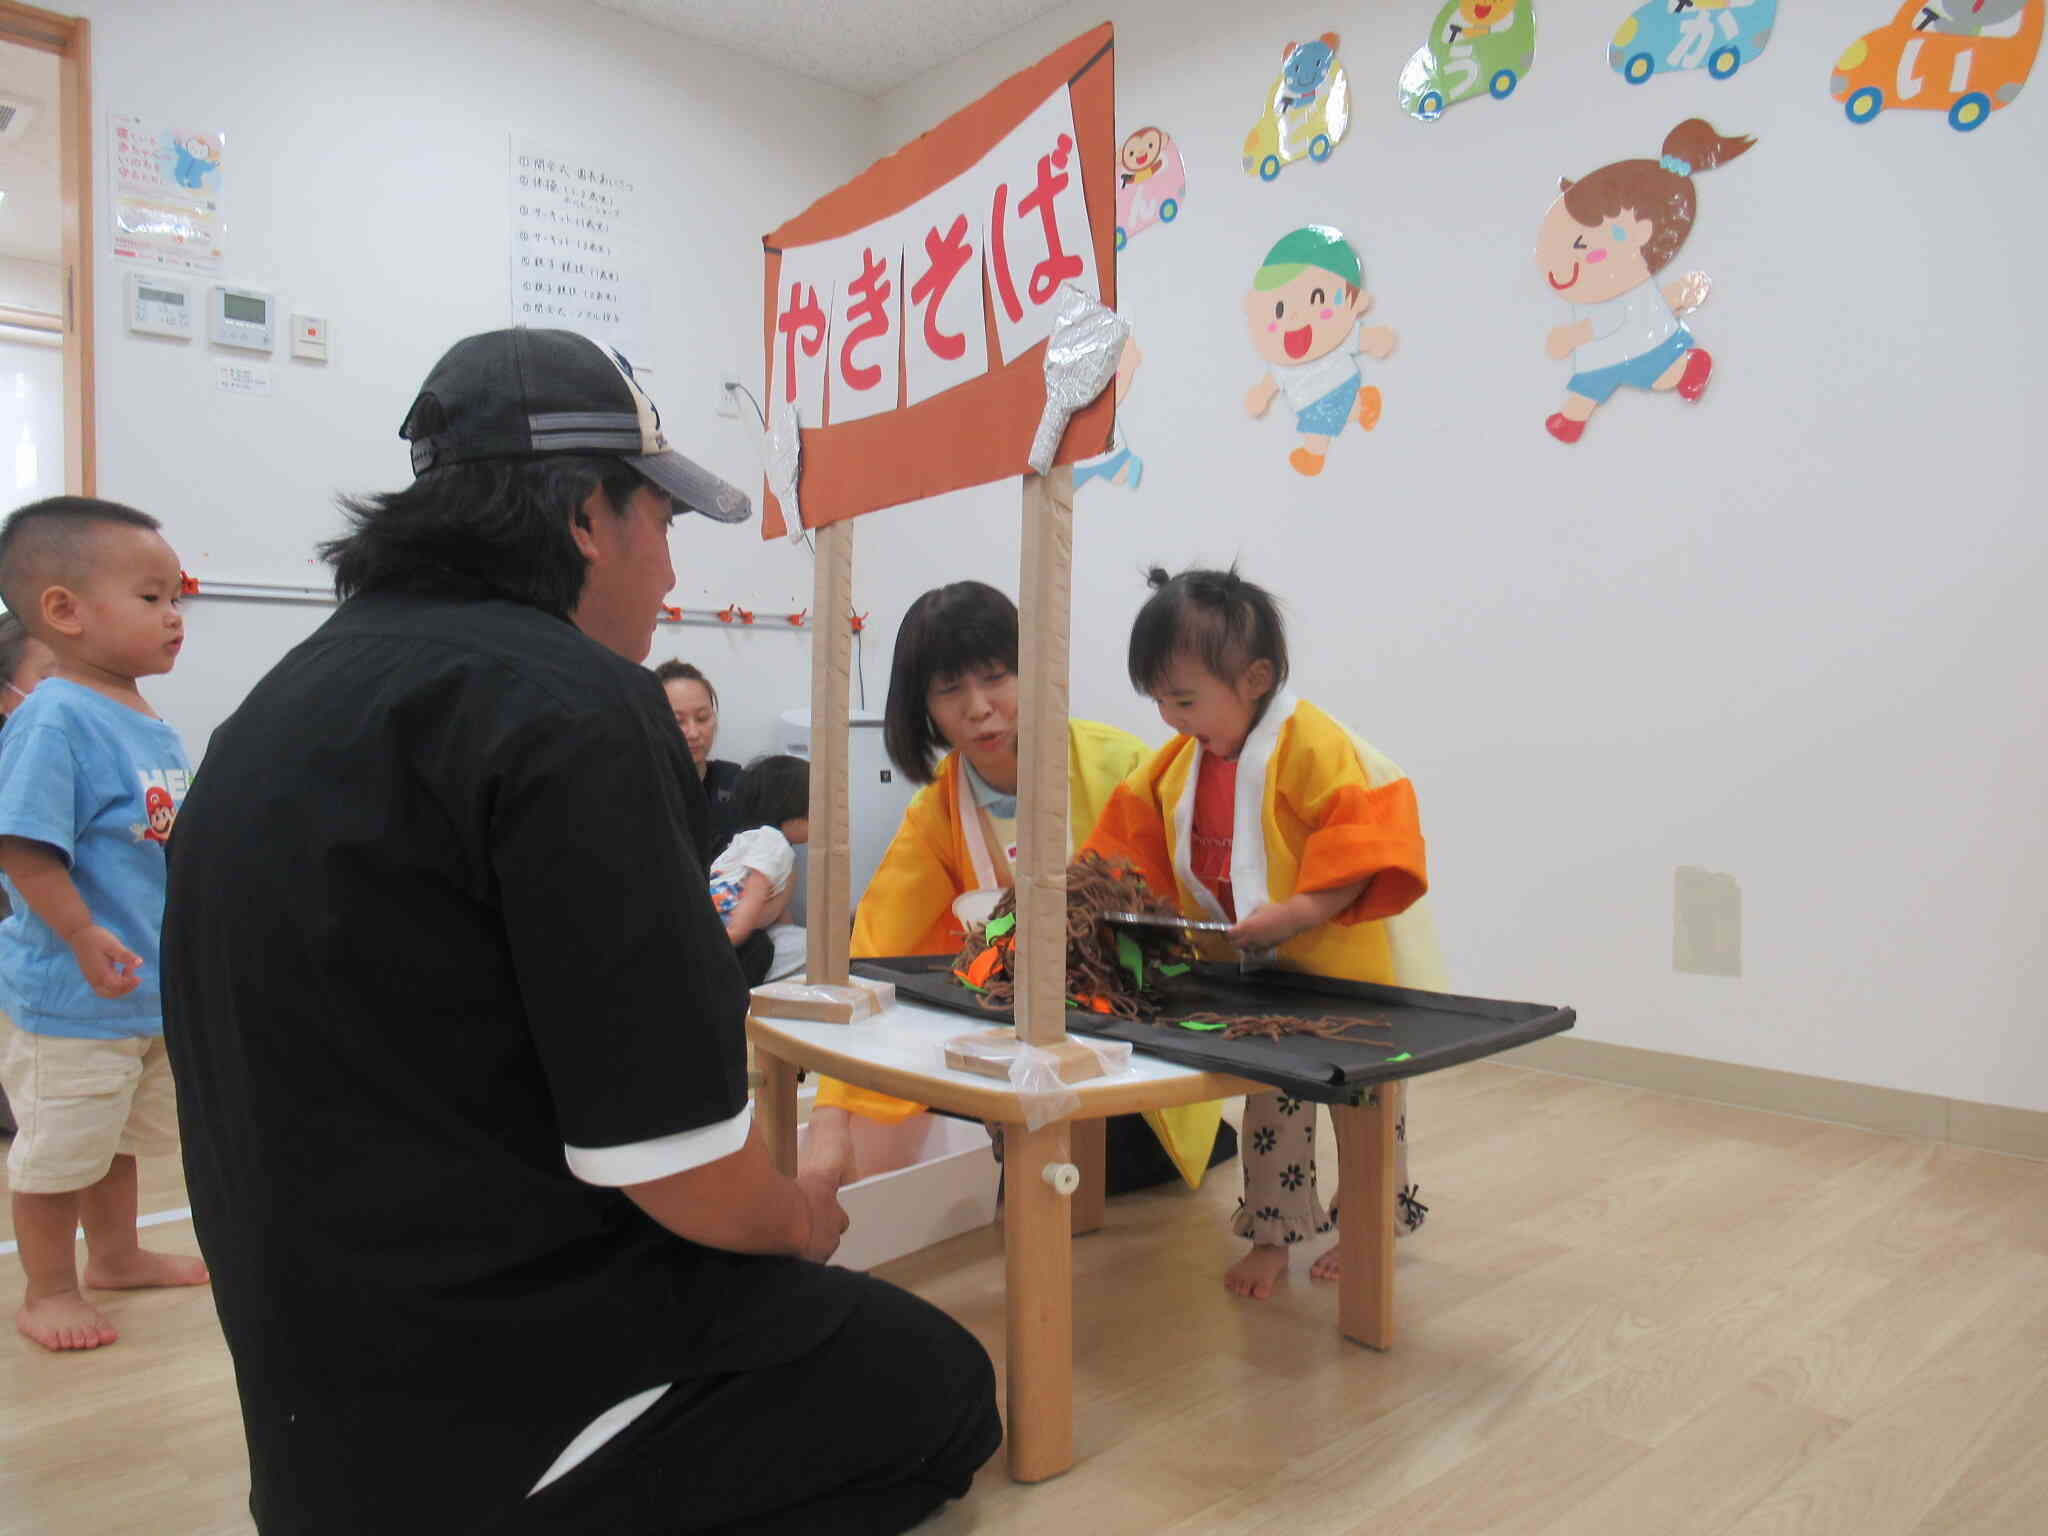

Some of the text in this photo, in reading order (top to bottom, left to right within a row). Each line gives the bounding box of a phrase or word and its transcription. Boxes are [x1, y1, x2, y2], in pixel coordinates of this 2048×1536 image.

[1666, 10, 1739, 69] か
[1896, 37, 1974, 101] い
[1443, 45, 1478, 99] う
[778, 133, 1084, 403] やきそば
